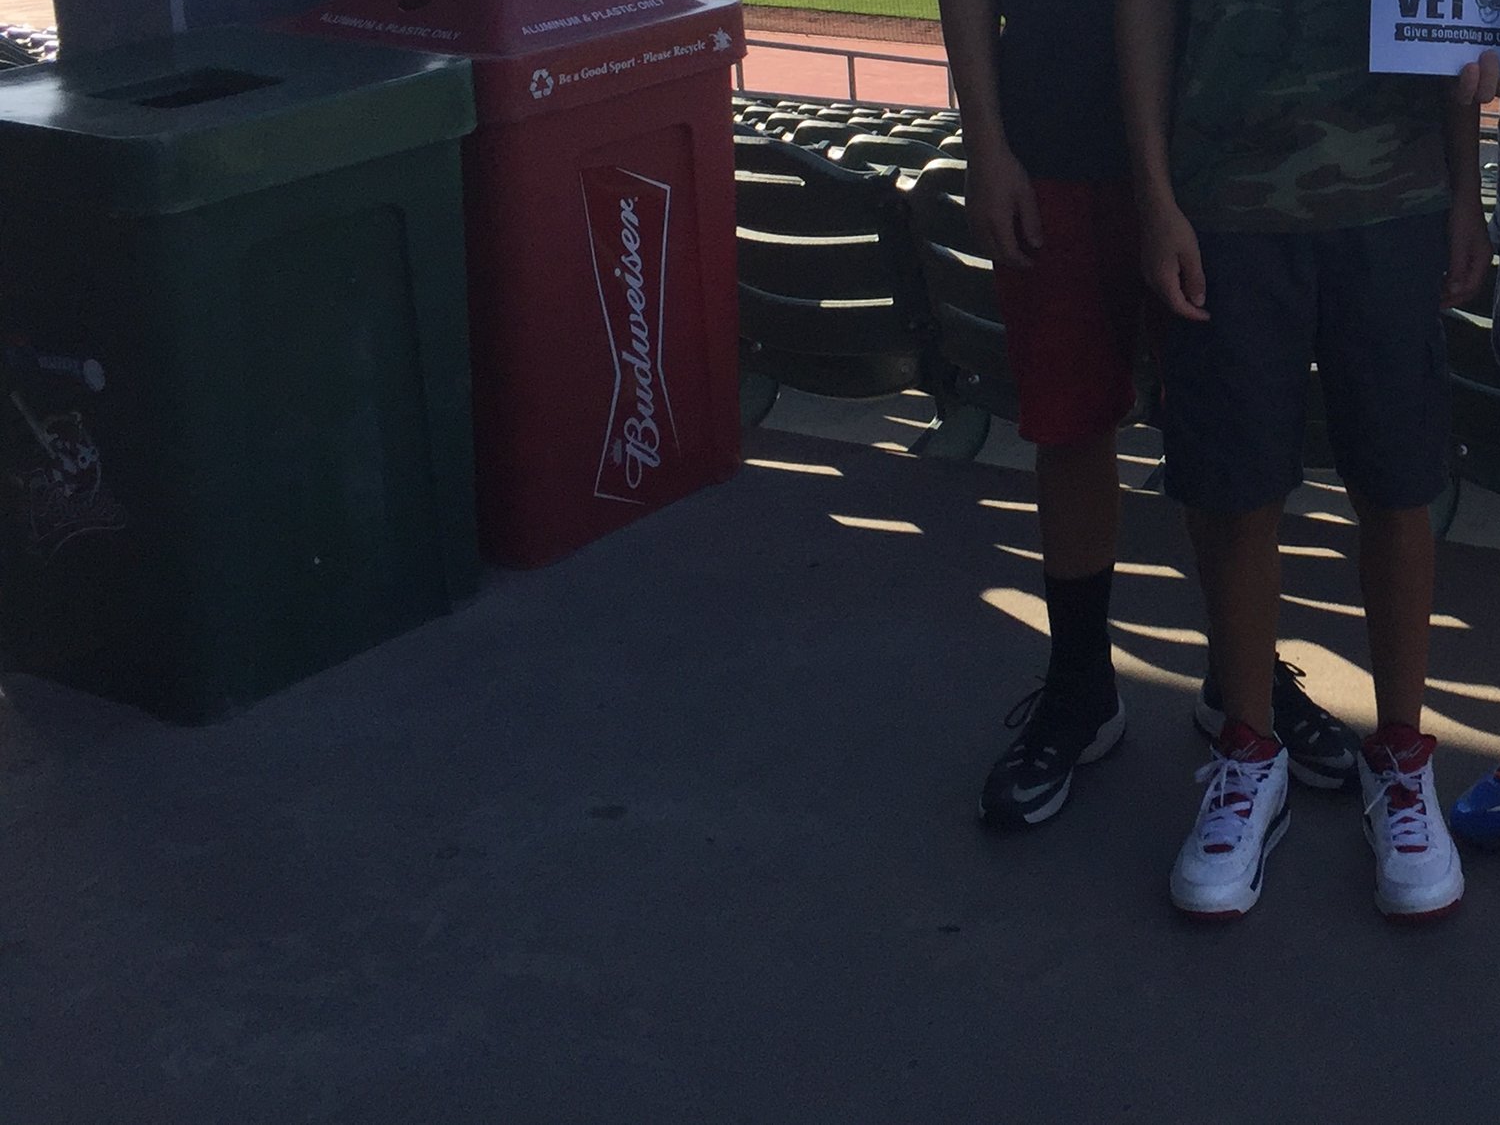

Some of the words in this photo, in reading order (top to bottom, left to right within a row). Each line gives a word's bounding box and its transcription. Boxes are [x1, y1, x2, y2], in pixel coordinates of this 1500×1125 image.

[521, 16, 582, 36] ALUMINUM
[582, 12, 592, 23] &
[593, 3, 637, 21] PLASTIC
[1403, 25, 1428, 38] Give
[1431, 25, 1482, 43] something
[1483, 31, 1494, 42] to
[558, 73, 571, 86] Be
[580, 62, 607, 80] Good
[608, 57, 636, 75] Sport
[643, 51, 671, 67] Please
[673, 39, 706, 57] Recycle
[614, 197, 662, 490] Budweiser
